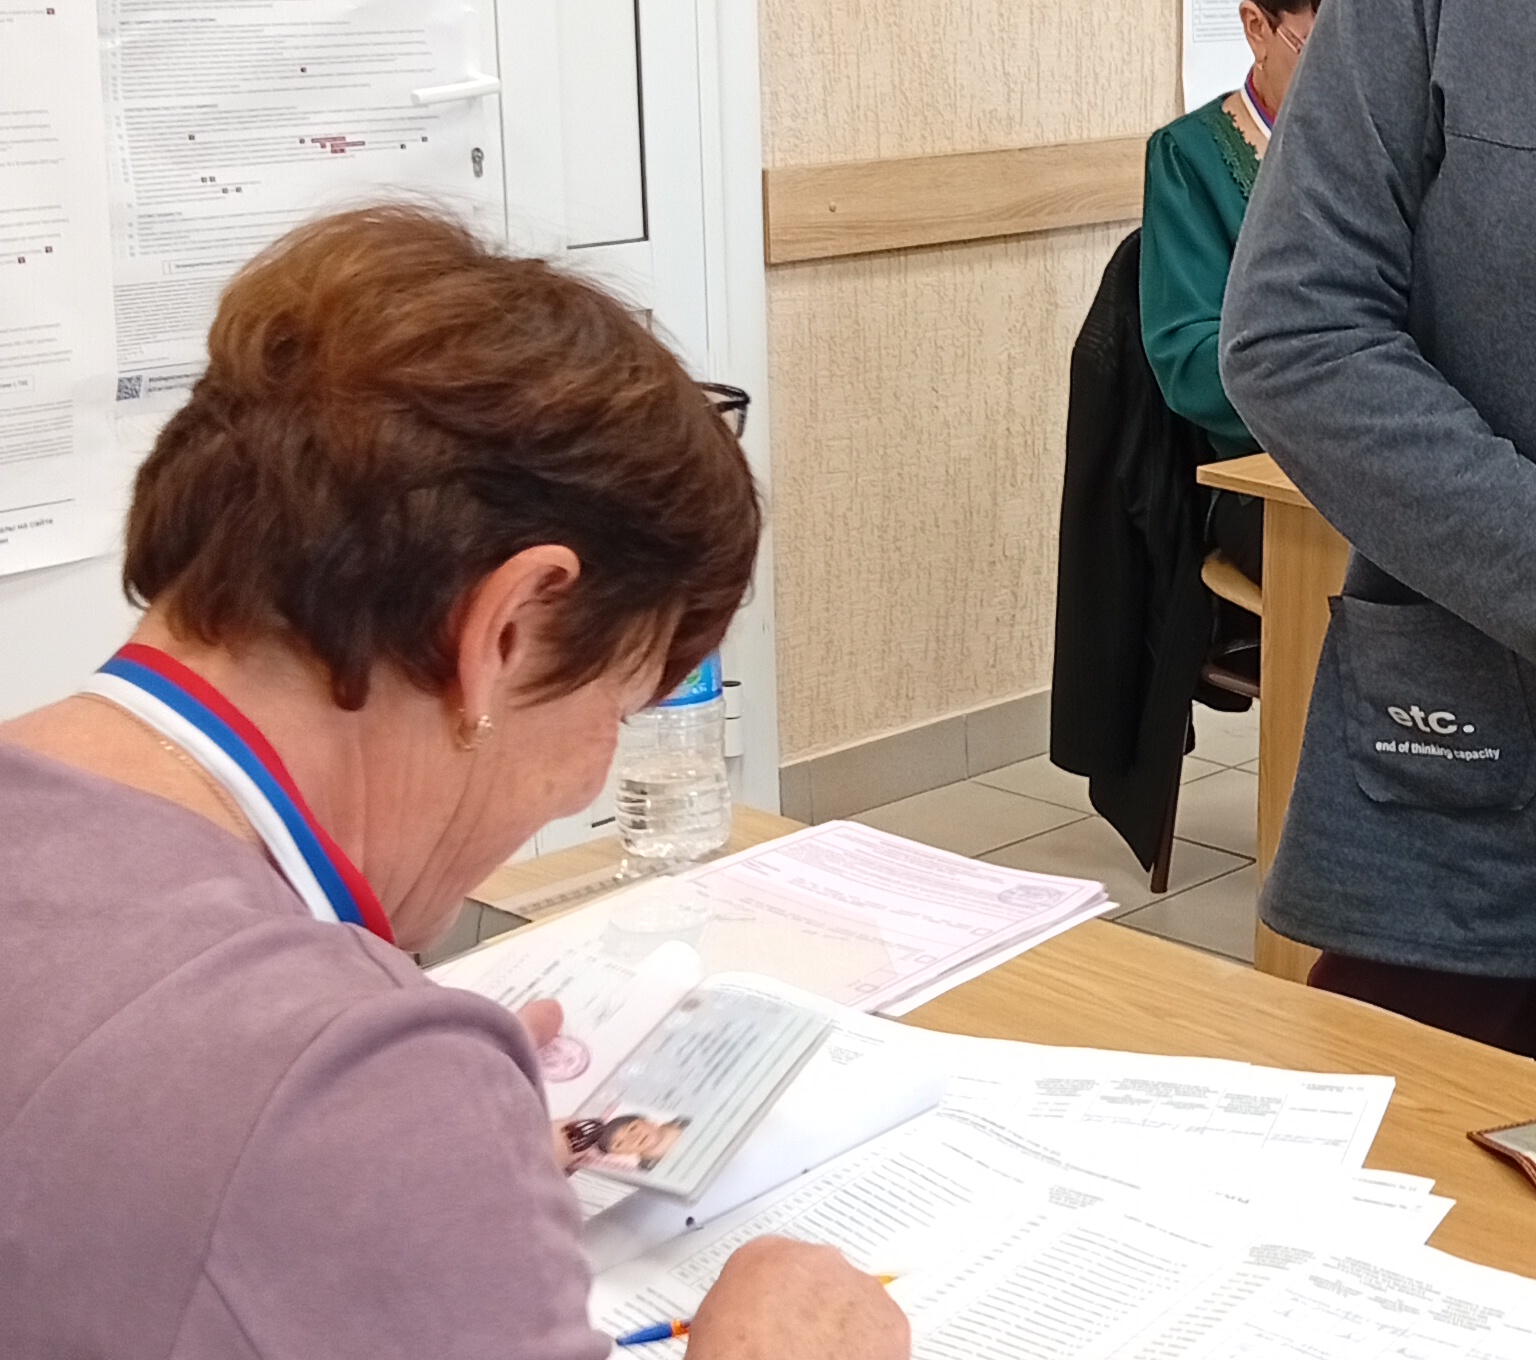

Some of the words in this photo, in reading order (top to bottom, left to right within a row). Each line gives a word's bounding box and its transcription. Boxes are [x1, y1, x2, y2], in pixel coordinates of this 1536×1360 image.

[1388, 705, 1475, 734] etc.
[1375, 740, 1397, 752] end
[1398, 741, 1410, 753] of
[1411, 742, 1453, 760] thinking
[1454, 748, 1501, 761] capacity
